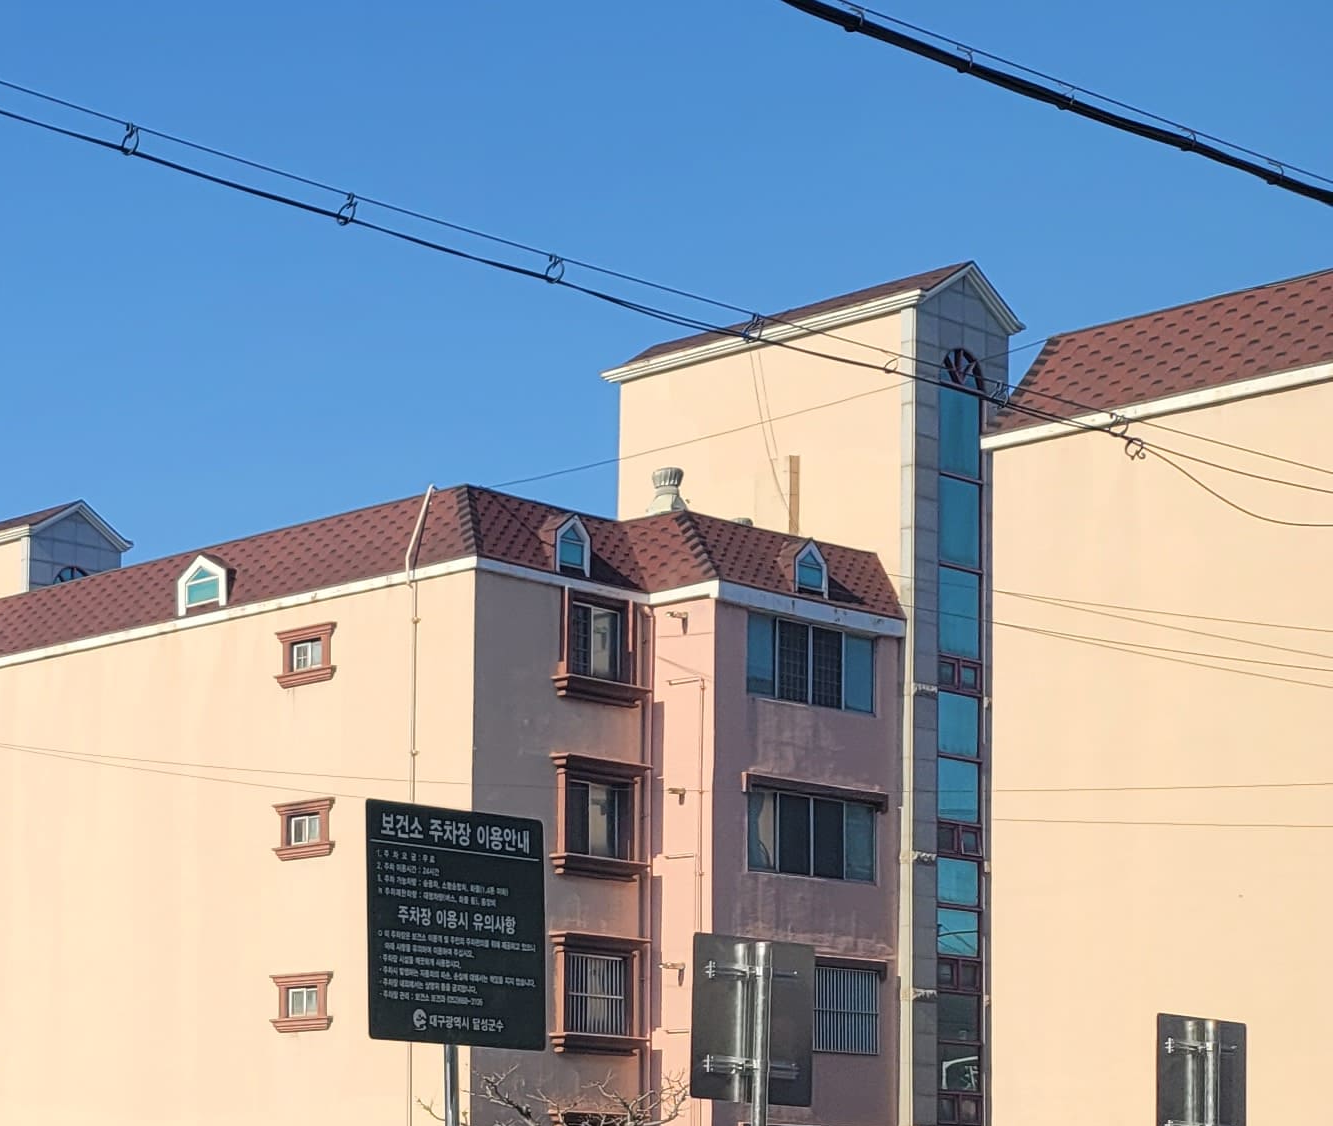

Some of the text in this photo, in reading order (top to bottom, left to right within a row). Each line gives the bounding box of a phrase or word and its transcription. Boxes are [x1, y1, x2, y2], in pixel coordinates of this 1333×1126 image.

[380, 812, 530, 854] 보건소 주차장 이용안내
[397, 905, 516, 935] 주차장 이용시 유의사항
[429, 1013, 504, 1032] 대구광역시 달성군수
